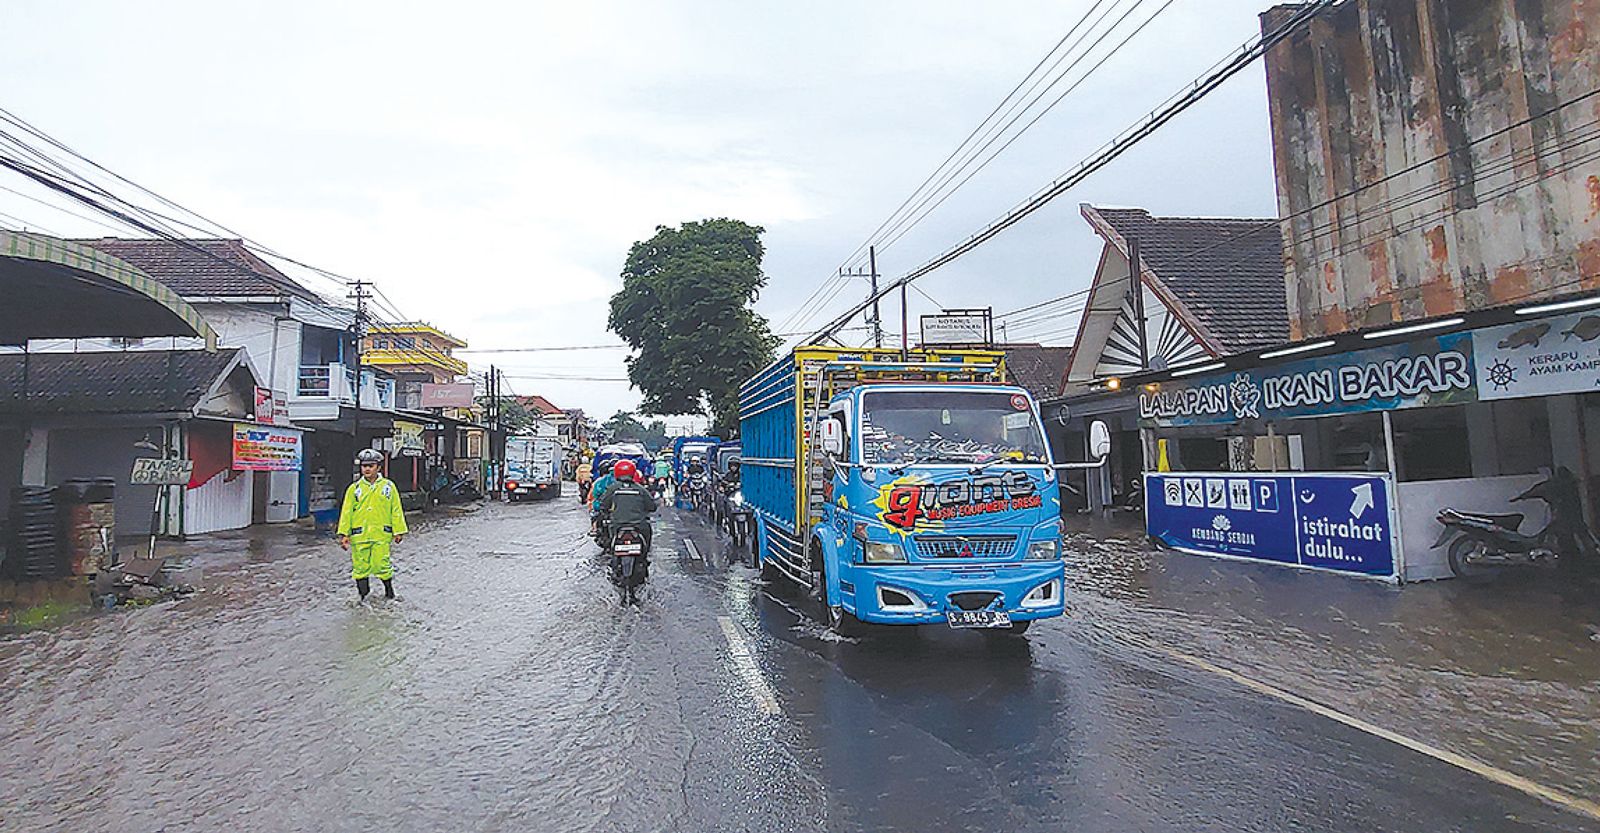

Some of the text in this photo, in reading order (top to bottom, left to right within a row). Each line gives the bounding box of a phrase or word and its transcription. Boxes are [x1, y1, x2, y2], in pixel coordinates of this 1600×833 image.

[1529, 351, 1578, 366] KERAPU
[1529, 364, 1561, 376] AYAM
[1138, 351, 1471, 418] LALAPAN IKAN BAKAR
[138, 460, 192, 471] TAMBAL
[959, 501, 1009, 516] EQUIPMENT
[1302, 515, 1382, 541] istirahat
[1304, 536, 1363, 562] dulu...
